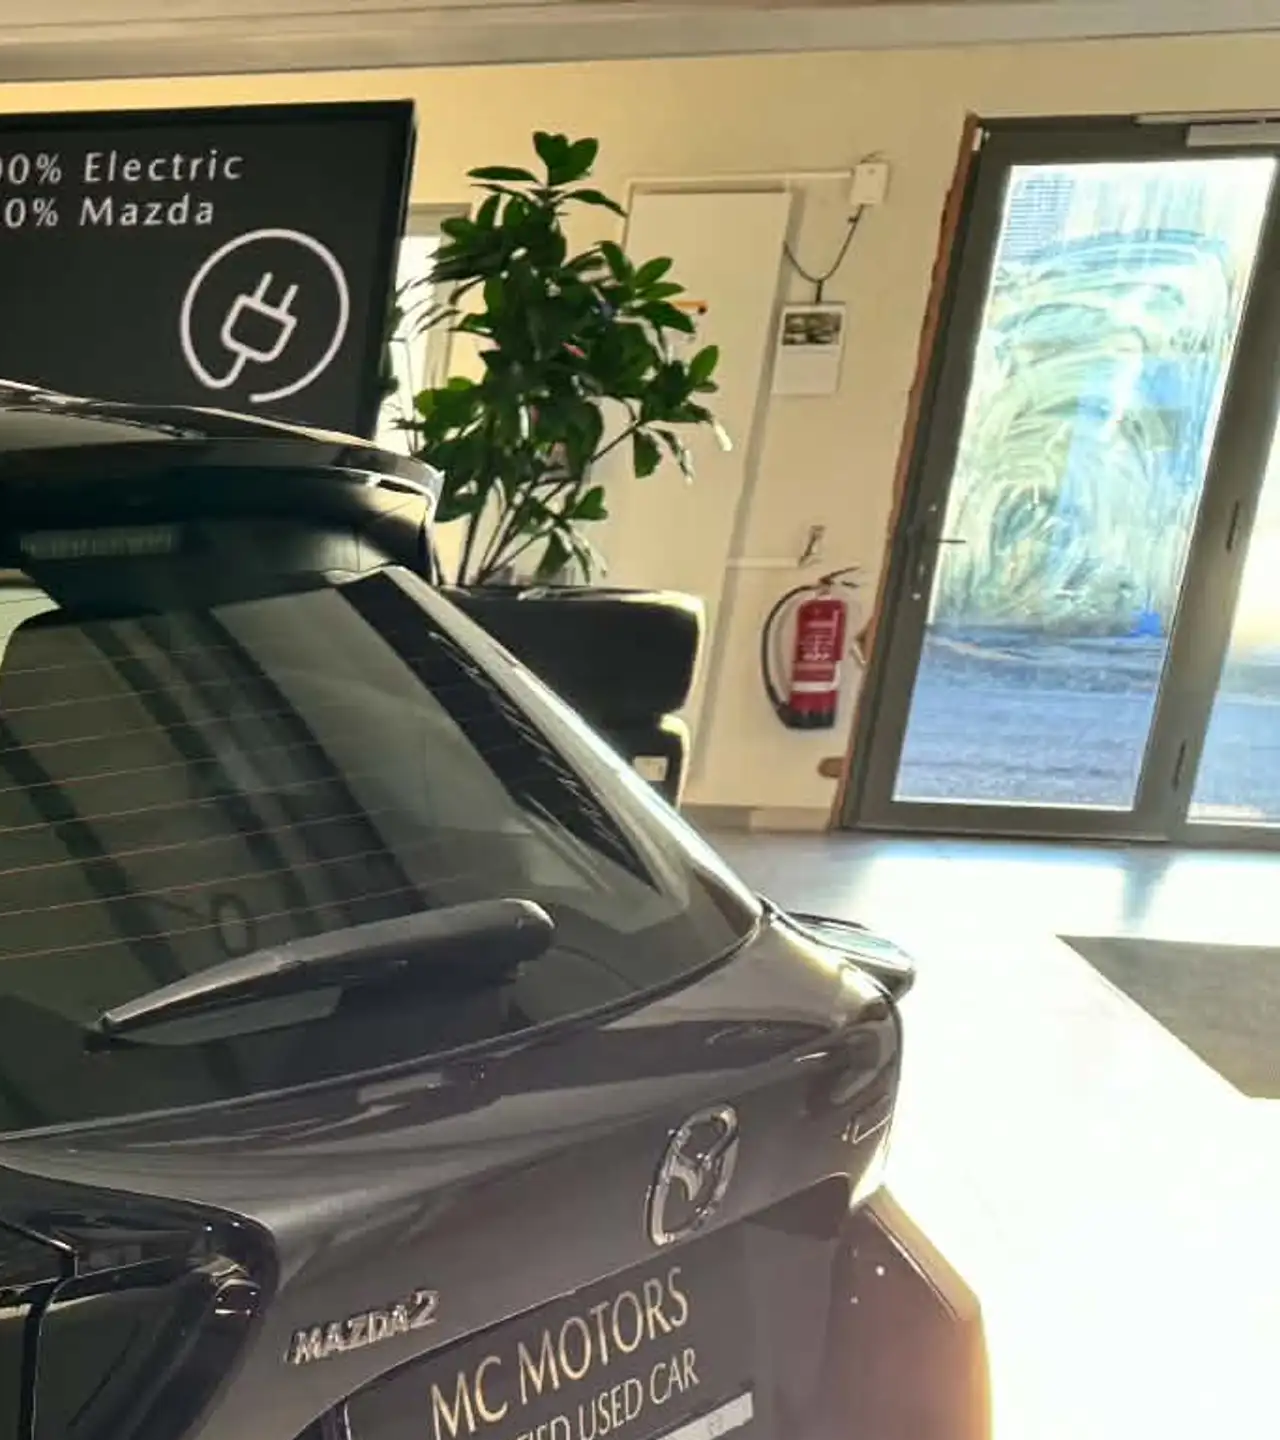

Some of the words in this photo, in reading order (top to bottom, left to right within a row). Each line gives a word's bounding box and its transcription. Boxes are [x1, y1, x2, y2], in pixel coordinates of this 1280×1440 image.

[84, 147, 244, 183] Electric
[80, 193, 215, 228] Mazda
[284, 1288, 441, 1365] MAZDA2
[517, 1266, 690, 1405] MOTORS
[649, 1347, 700, 1404] CAR
